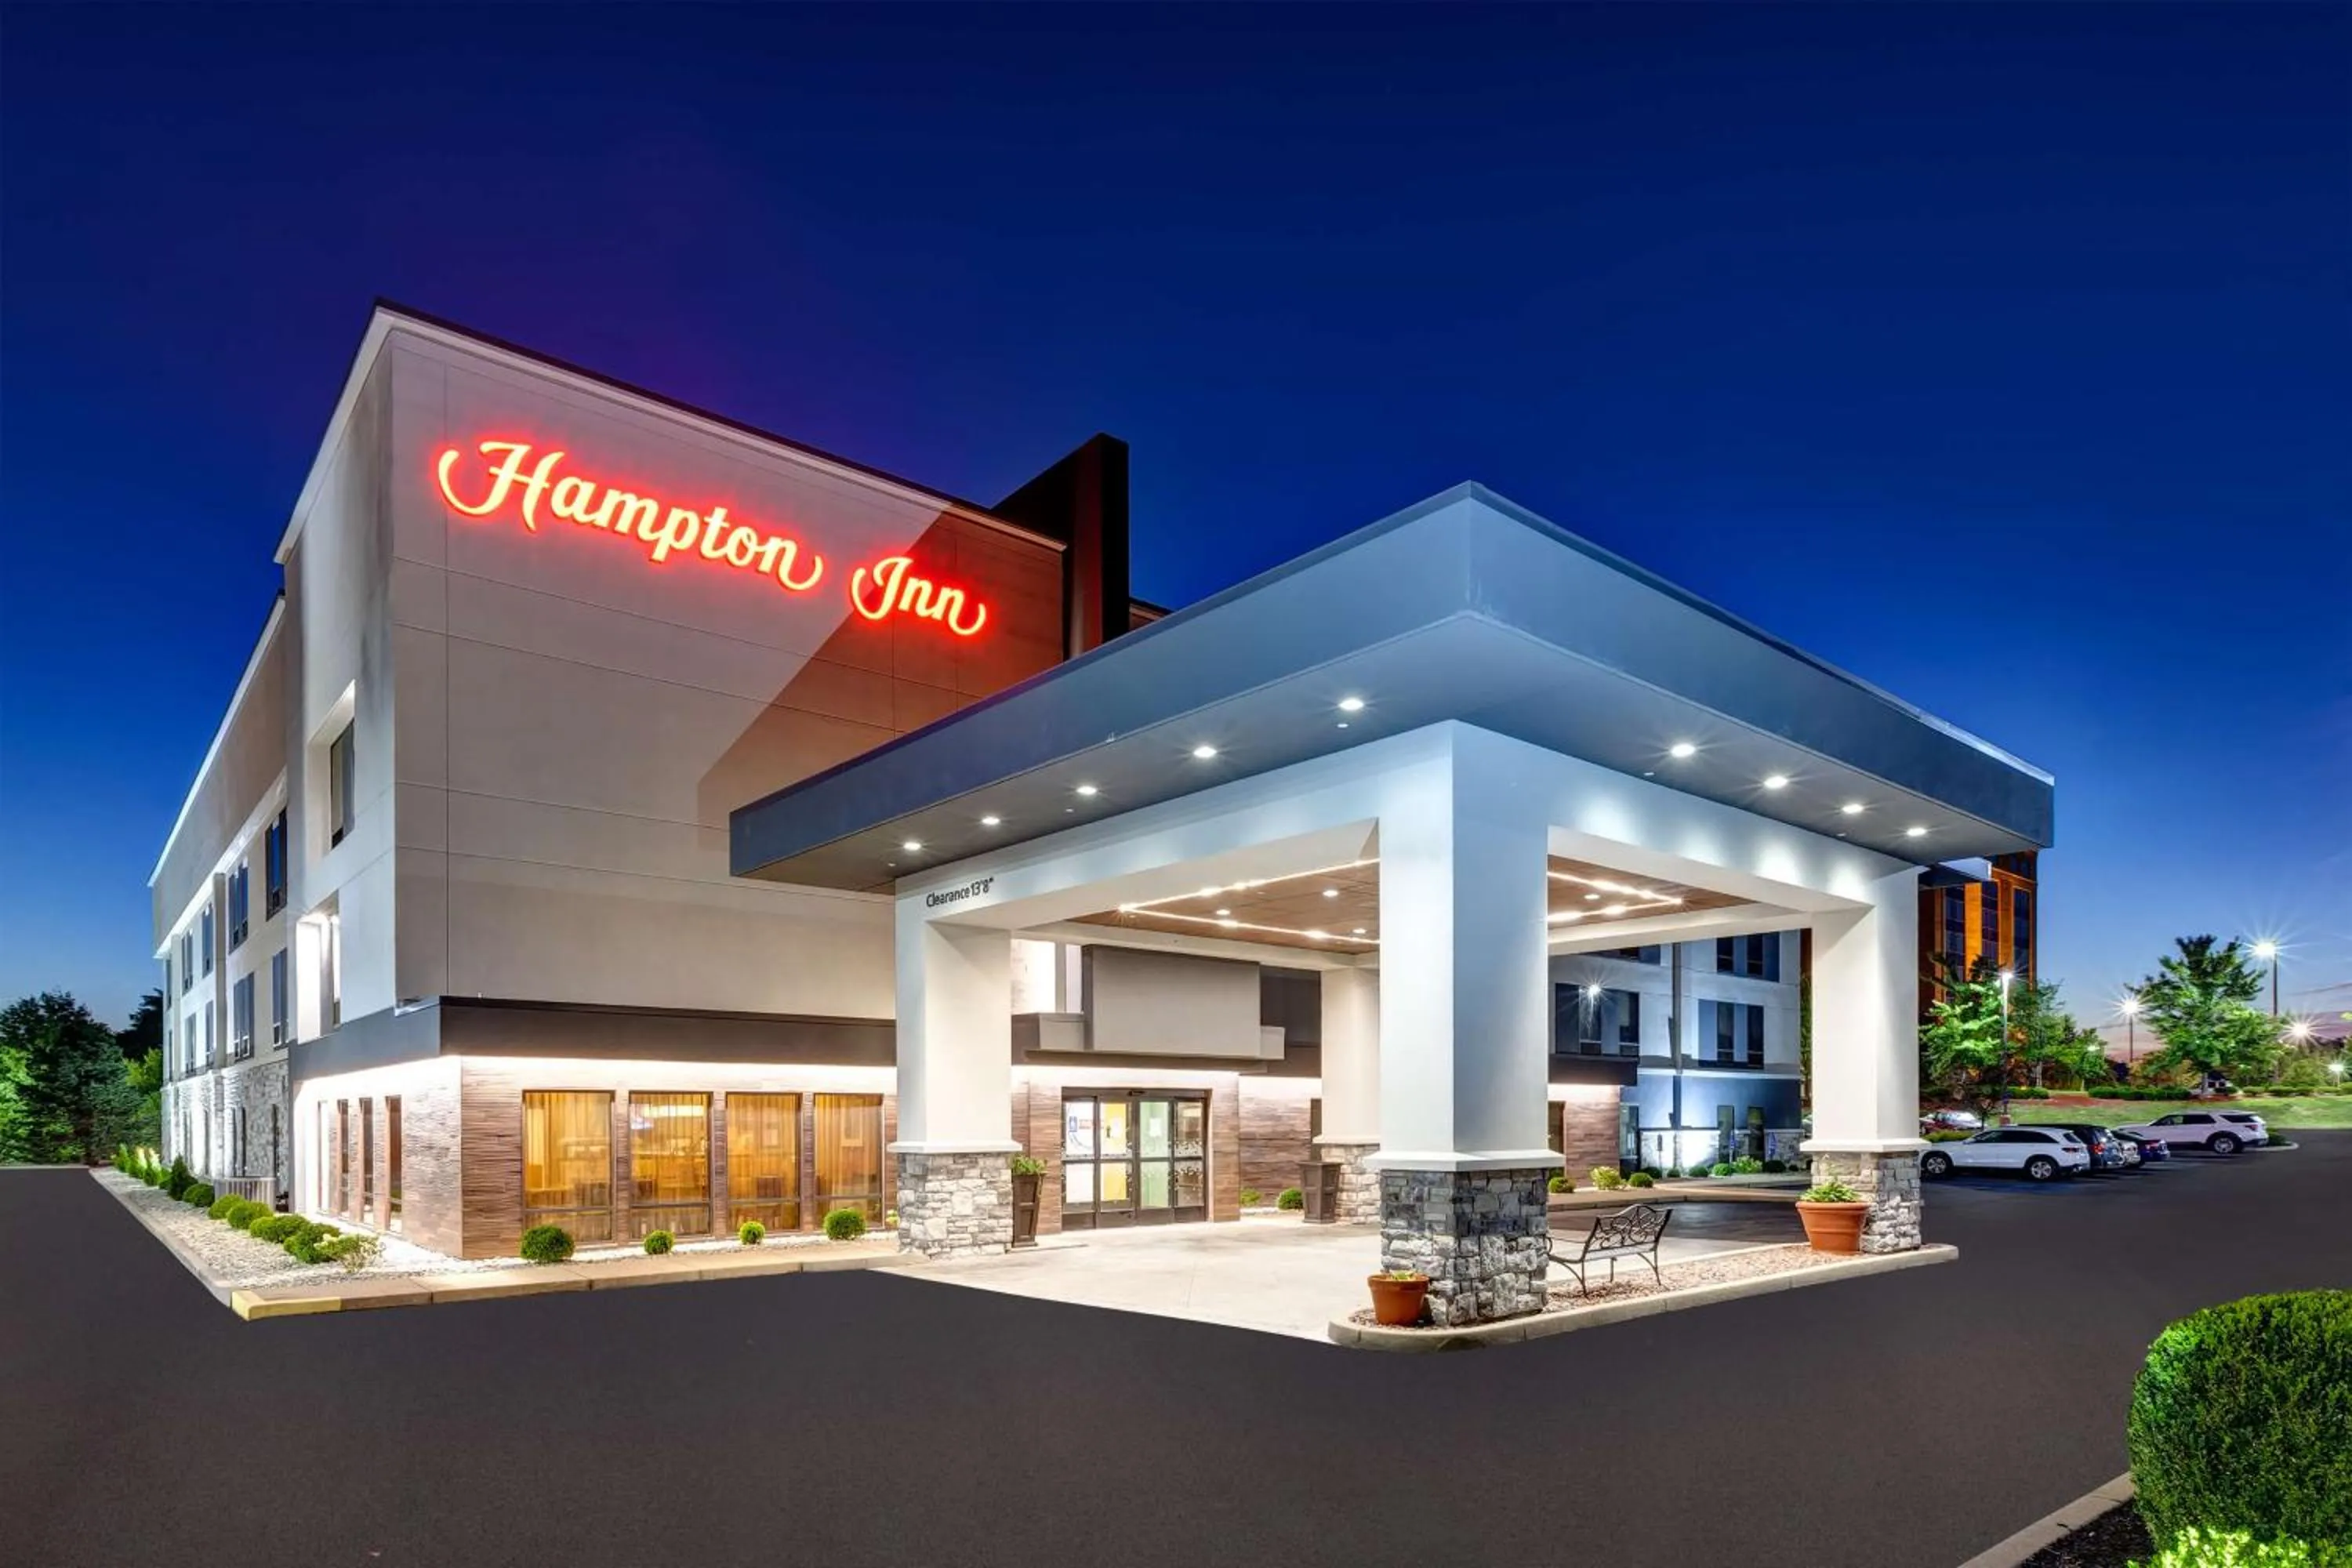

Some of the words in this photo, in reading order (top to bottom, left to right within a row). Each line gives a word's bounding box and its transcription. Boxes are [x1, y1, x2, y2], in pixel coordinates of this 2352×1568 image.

[437, 441, 823, 591] Hampton
[851, 556, 986, 636] Inn
[926, 887, 970, 907] Clearance
